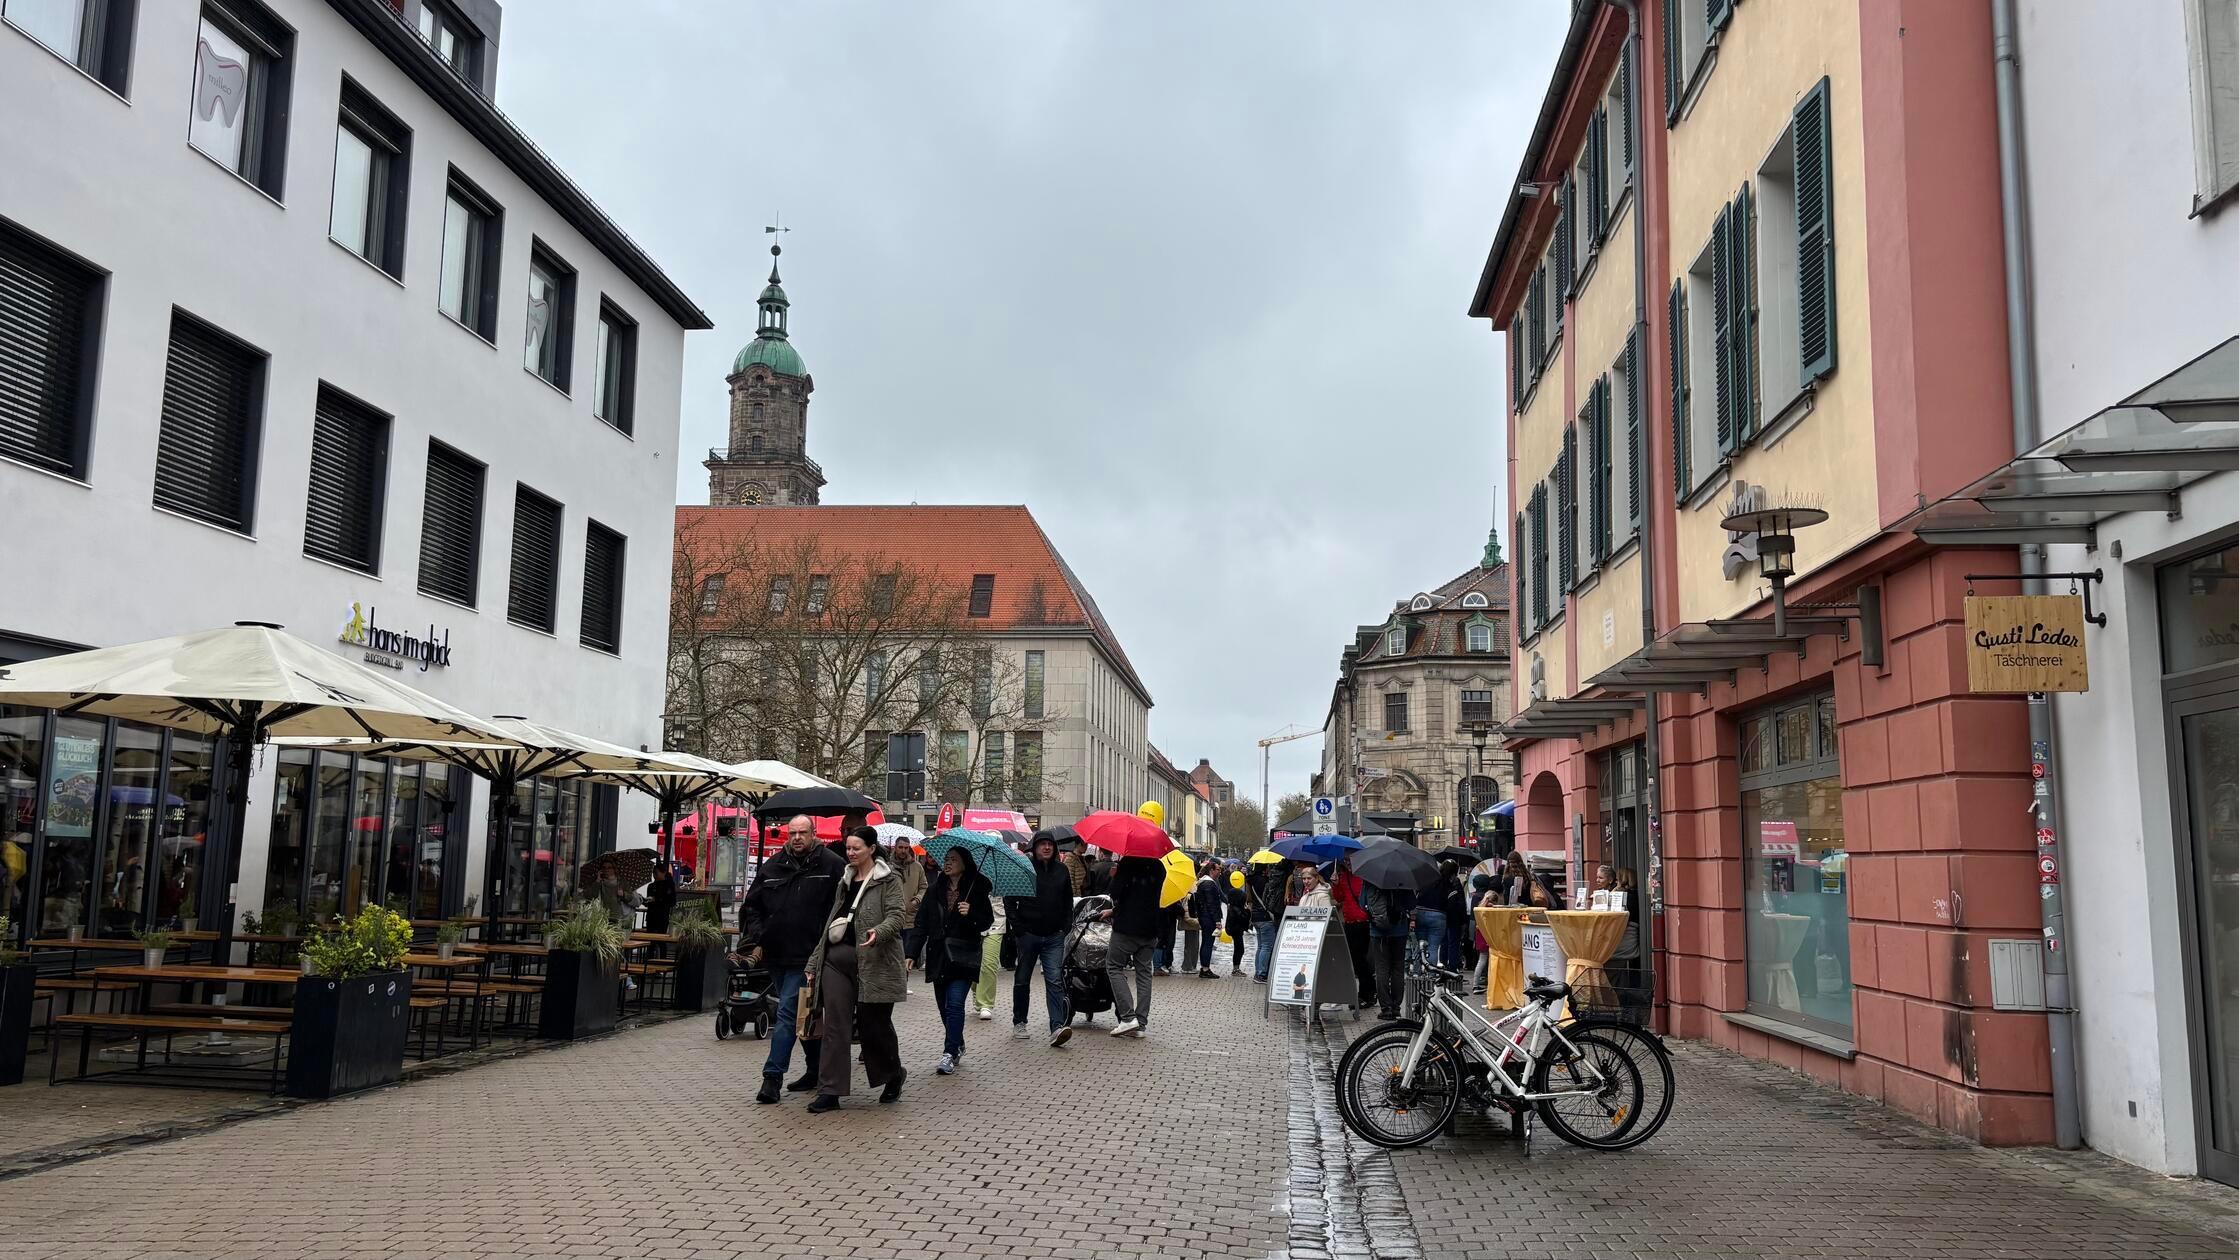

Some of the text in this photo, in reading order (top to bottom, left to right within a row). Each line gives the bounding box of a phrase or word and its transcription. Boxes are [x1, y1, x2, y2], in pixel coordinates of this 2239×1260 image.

[369, 606, 452, 672] hans im glück
[1975, 623, 2079, 650] Gusti Leder
[1994, 654, 2063, 667] Täschnerei
[1523, 934, 1540, 949] ANG
